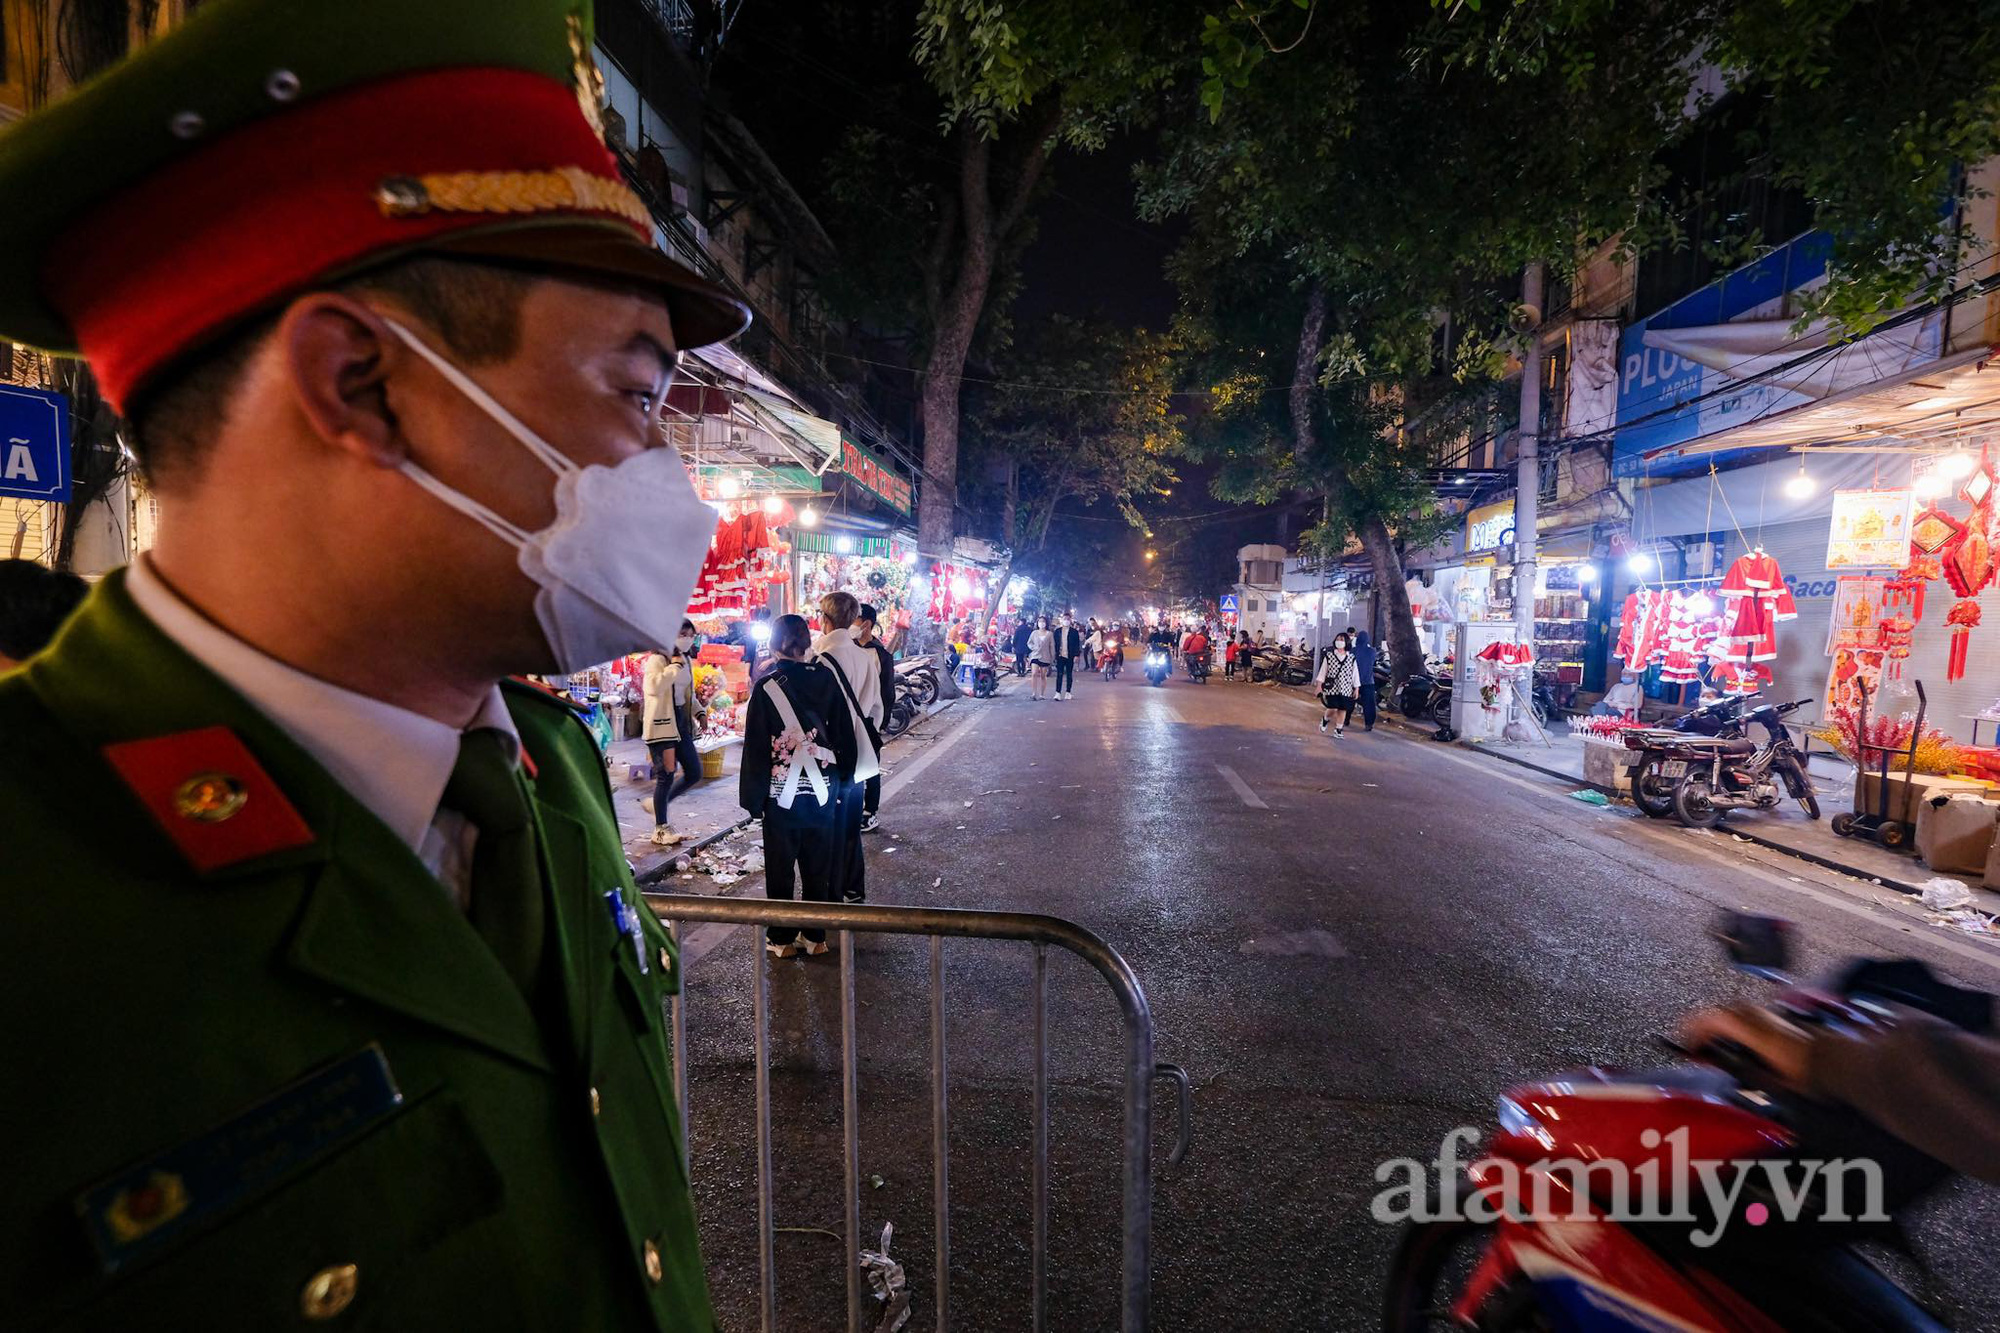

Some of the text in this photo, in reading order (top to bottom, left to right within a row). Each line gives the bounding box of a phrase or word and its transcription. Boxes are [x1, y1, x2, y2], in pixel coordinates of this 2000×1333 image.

[1658, 375, 1698, 401] JAPAN
[0, 437, 39, 482] Ã
[1783, 574, 1837, 598] Saco
